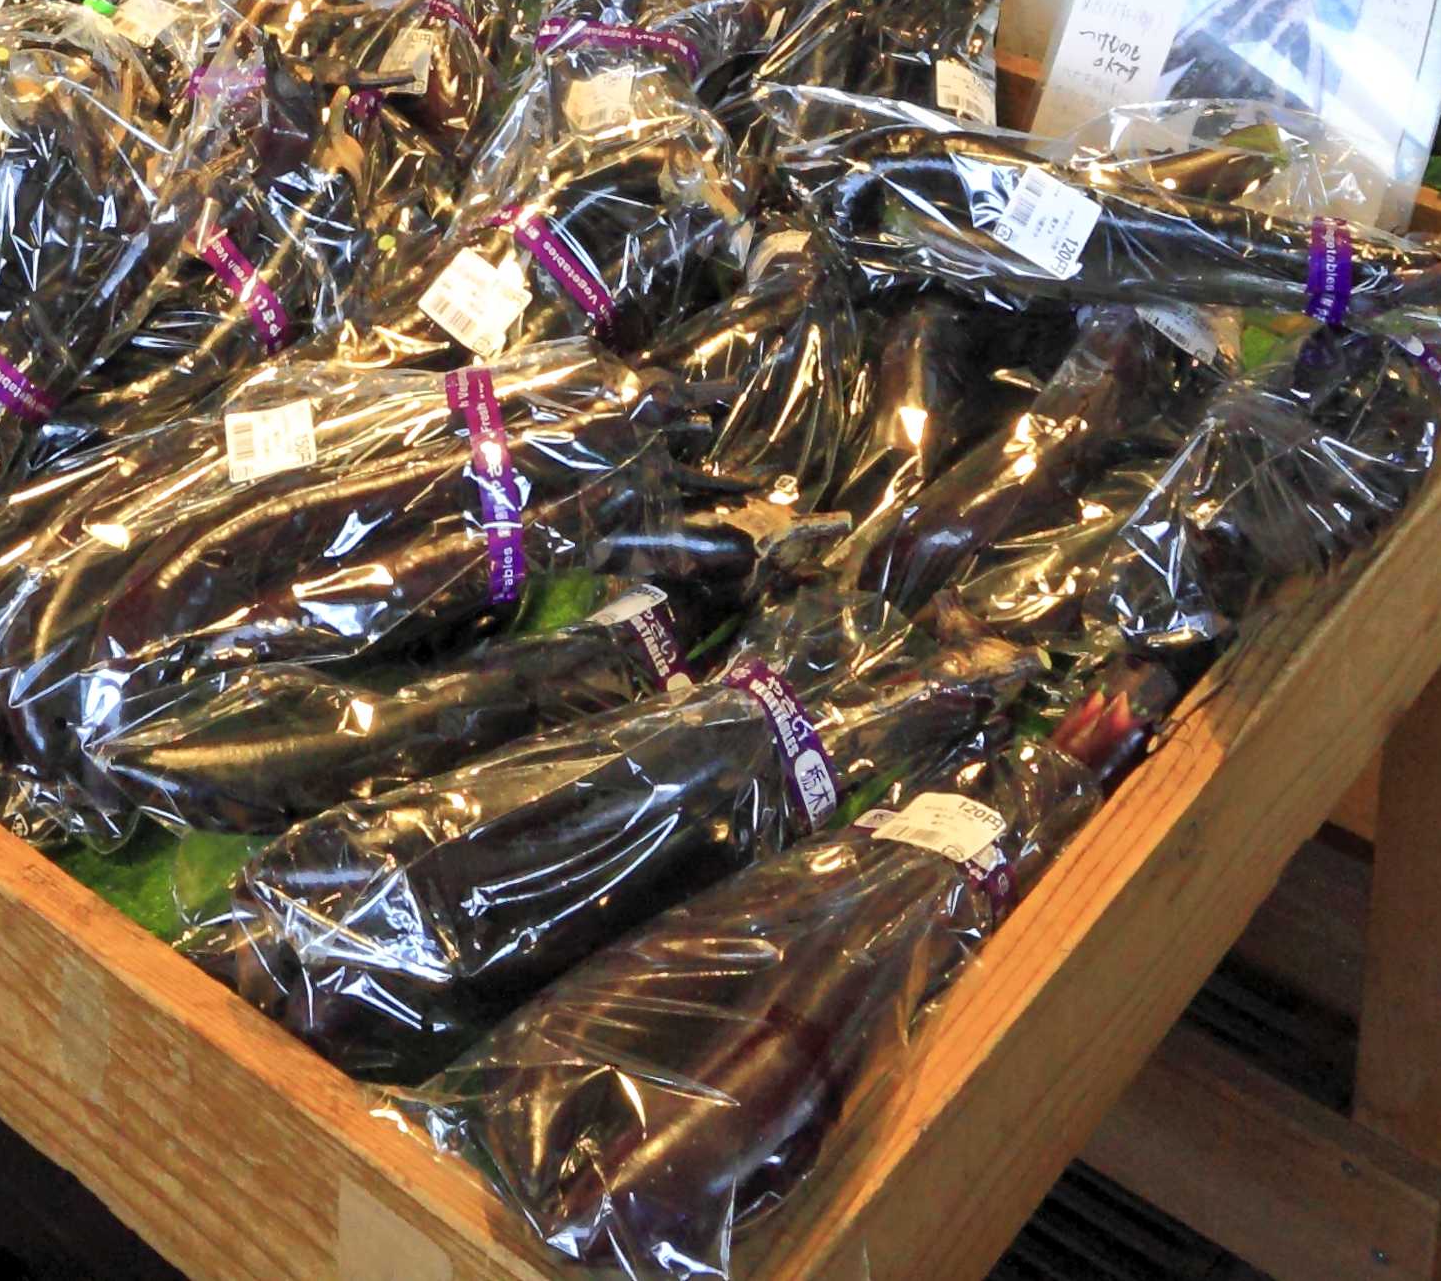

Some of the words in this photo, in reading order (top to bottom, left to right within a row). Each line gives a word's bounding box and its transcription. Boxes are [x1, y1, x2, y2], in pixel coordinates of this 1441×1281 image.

[1046, 233, 1082, 280] 120円
[765, 681, 812, 743] やさい
[958, 800, 1003, 831] 120円
